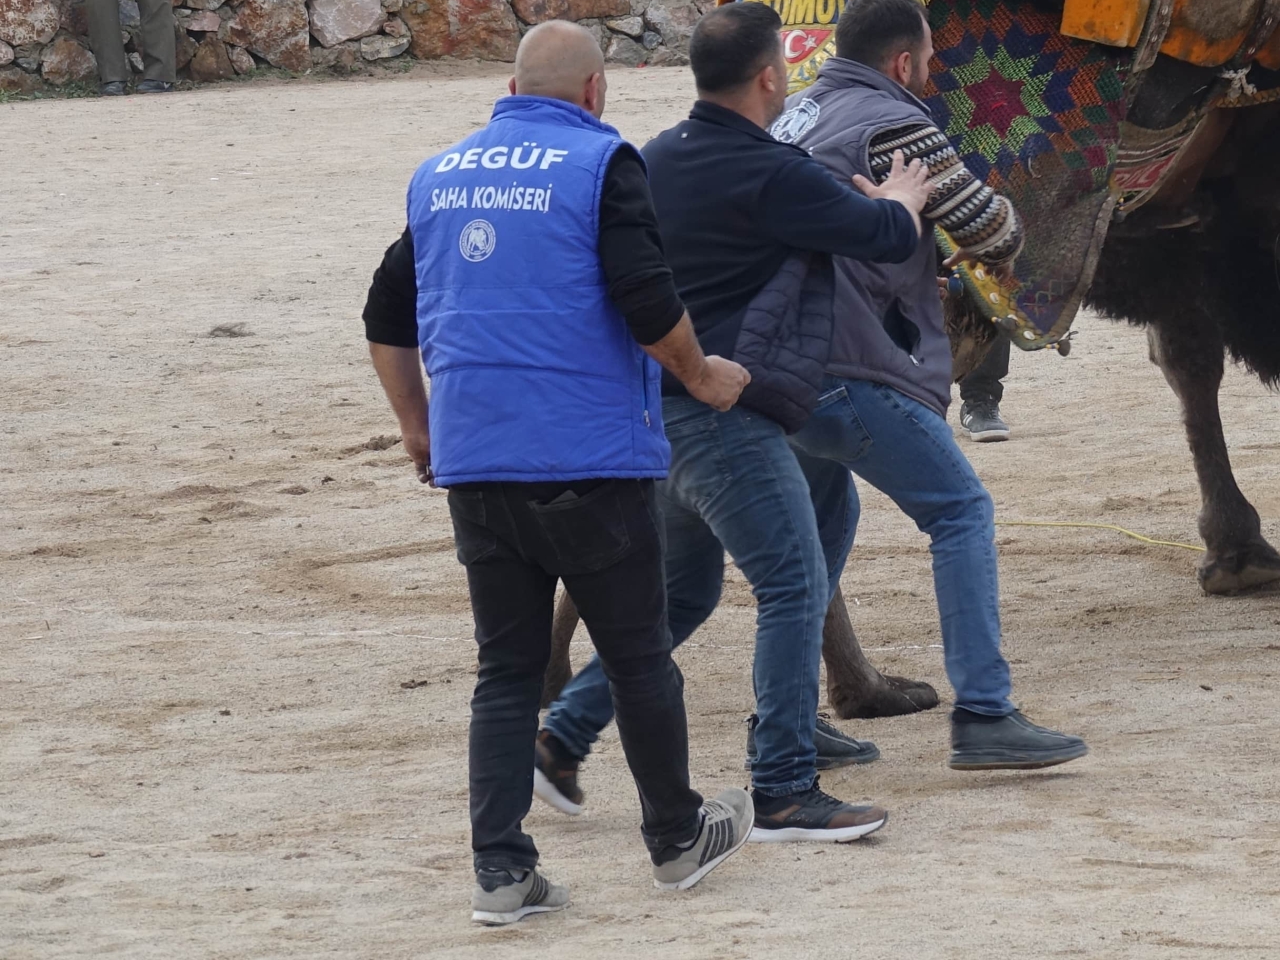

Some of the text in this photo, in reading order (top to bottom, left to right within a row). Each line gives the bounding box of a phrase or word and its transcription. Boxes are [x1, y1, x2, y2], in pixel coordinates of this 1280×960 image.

[435, 142, 568, 173] DEGÜF
[430, 181, 552, 213] SAHA KOMİSERİ
